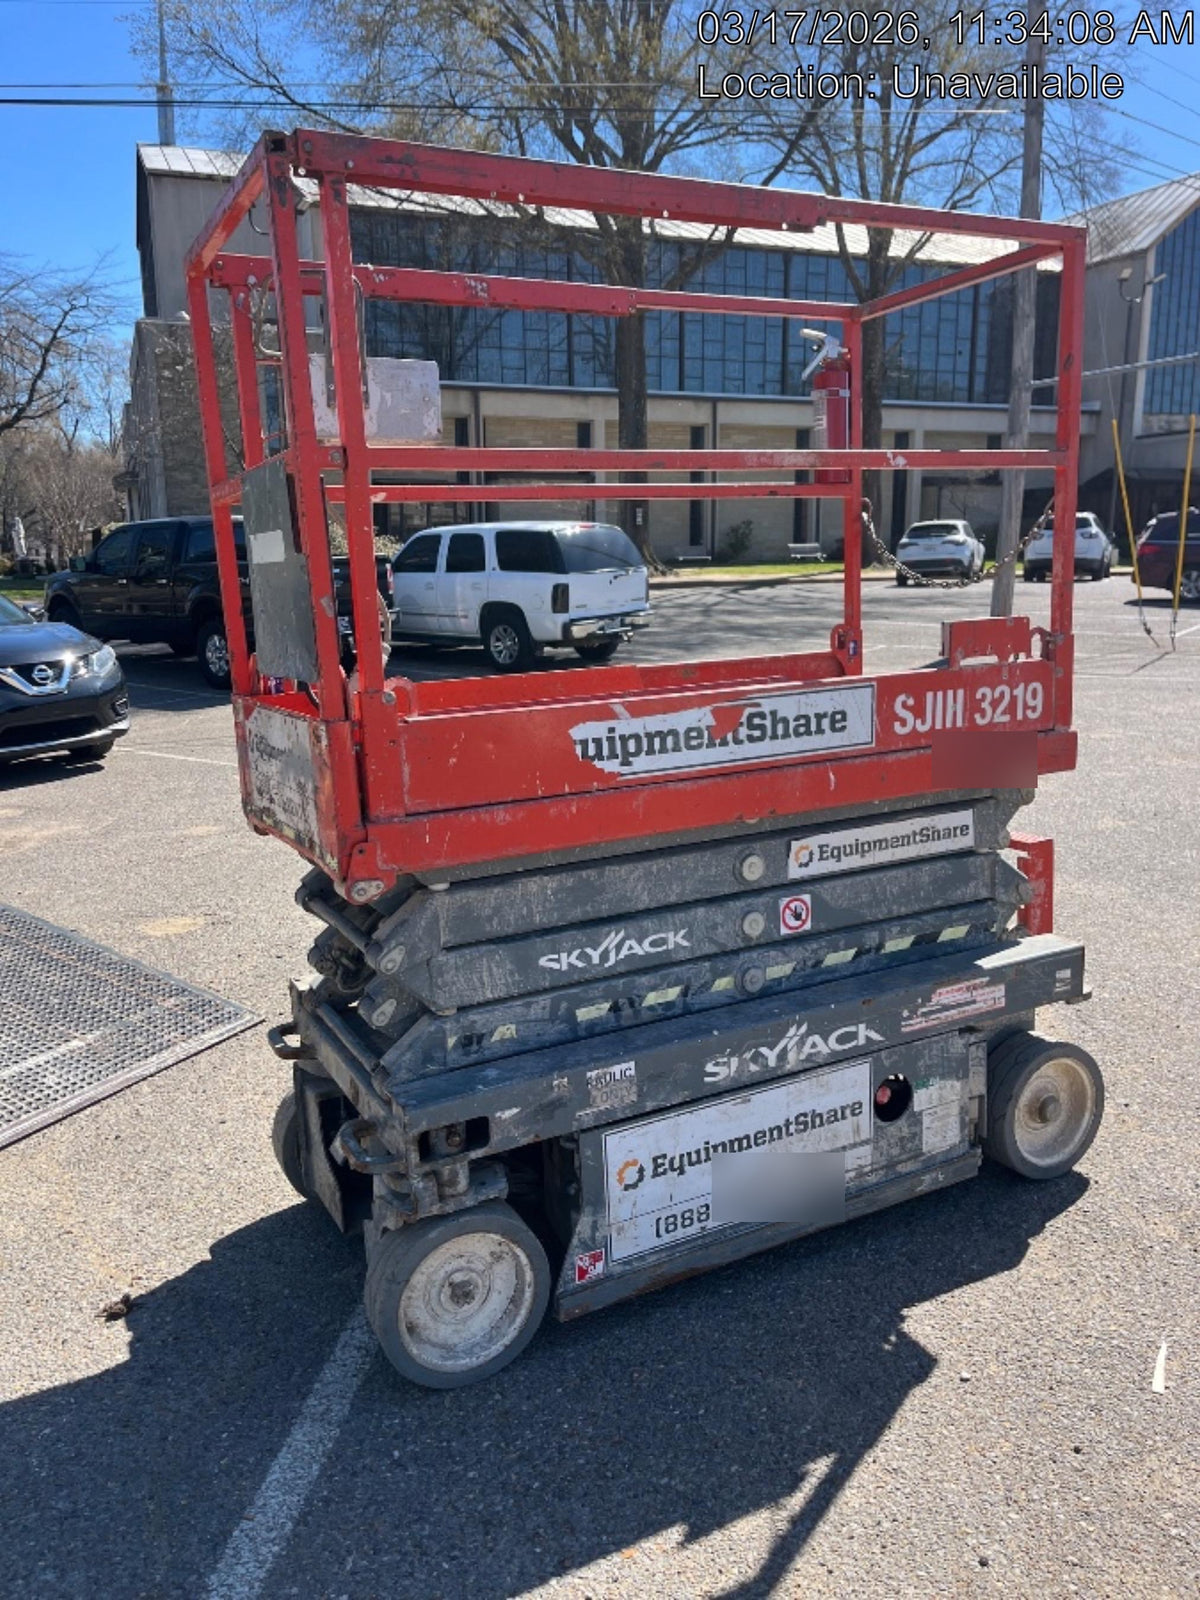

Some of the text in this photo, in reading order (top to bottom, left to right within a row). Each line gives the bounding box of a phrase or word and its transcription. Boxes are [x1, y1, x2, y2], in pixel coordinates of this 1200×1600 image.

[974, 682, 1043, 726] 3219
[817, 824, 970, 863] EquipmentShare
[538, 928, 691, 971] SKYJACK
[703, 1021, 886, 1083] SKYJACK
